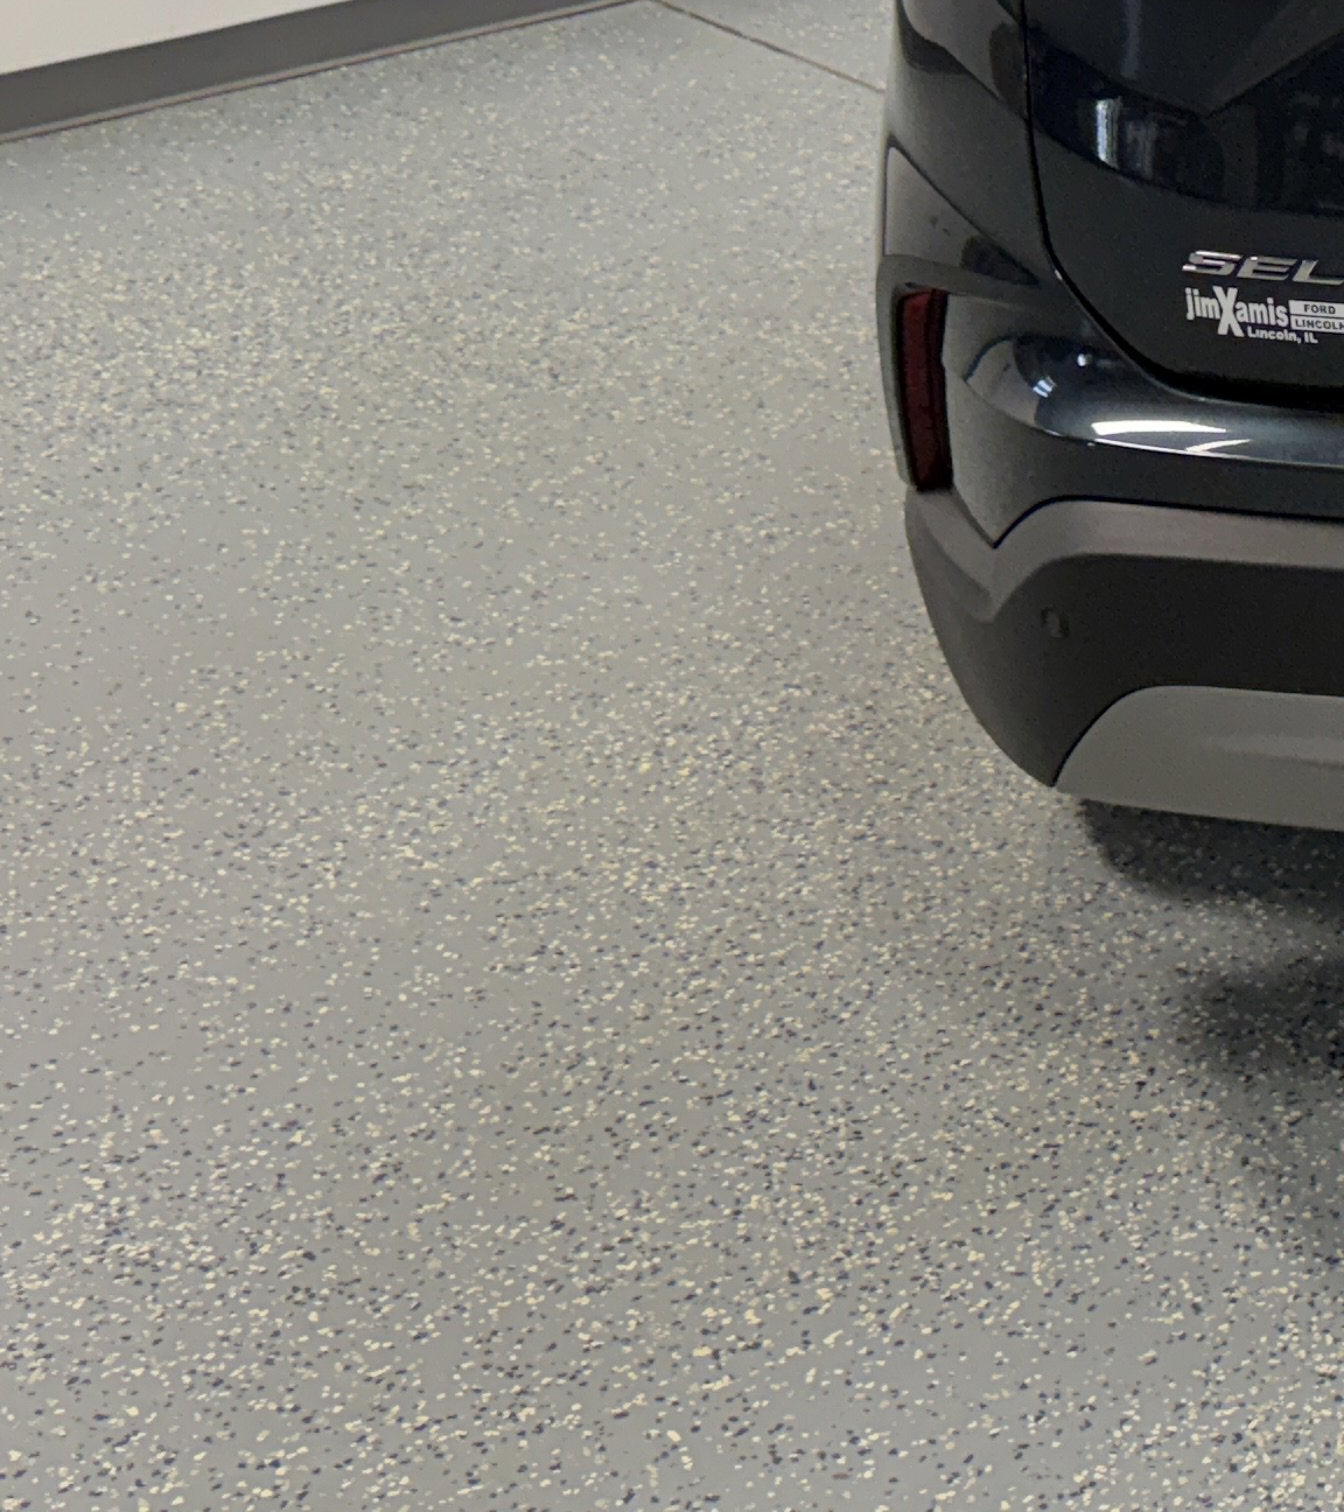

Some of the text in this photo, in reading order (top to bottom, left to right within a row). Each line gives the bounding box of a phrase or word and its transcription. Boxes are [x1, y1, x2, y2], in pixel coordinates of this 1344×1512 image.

[1303, 303, 1336, 315] FORD
[1247, 326, 1319, 344] Lincoln, IL
